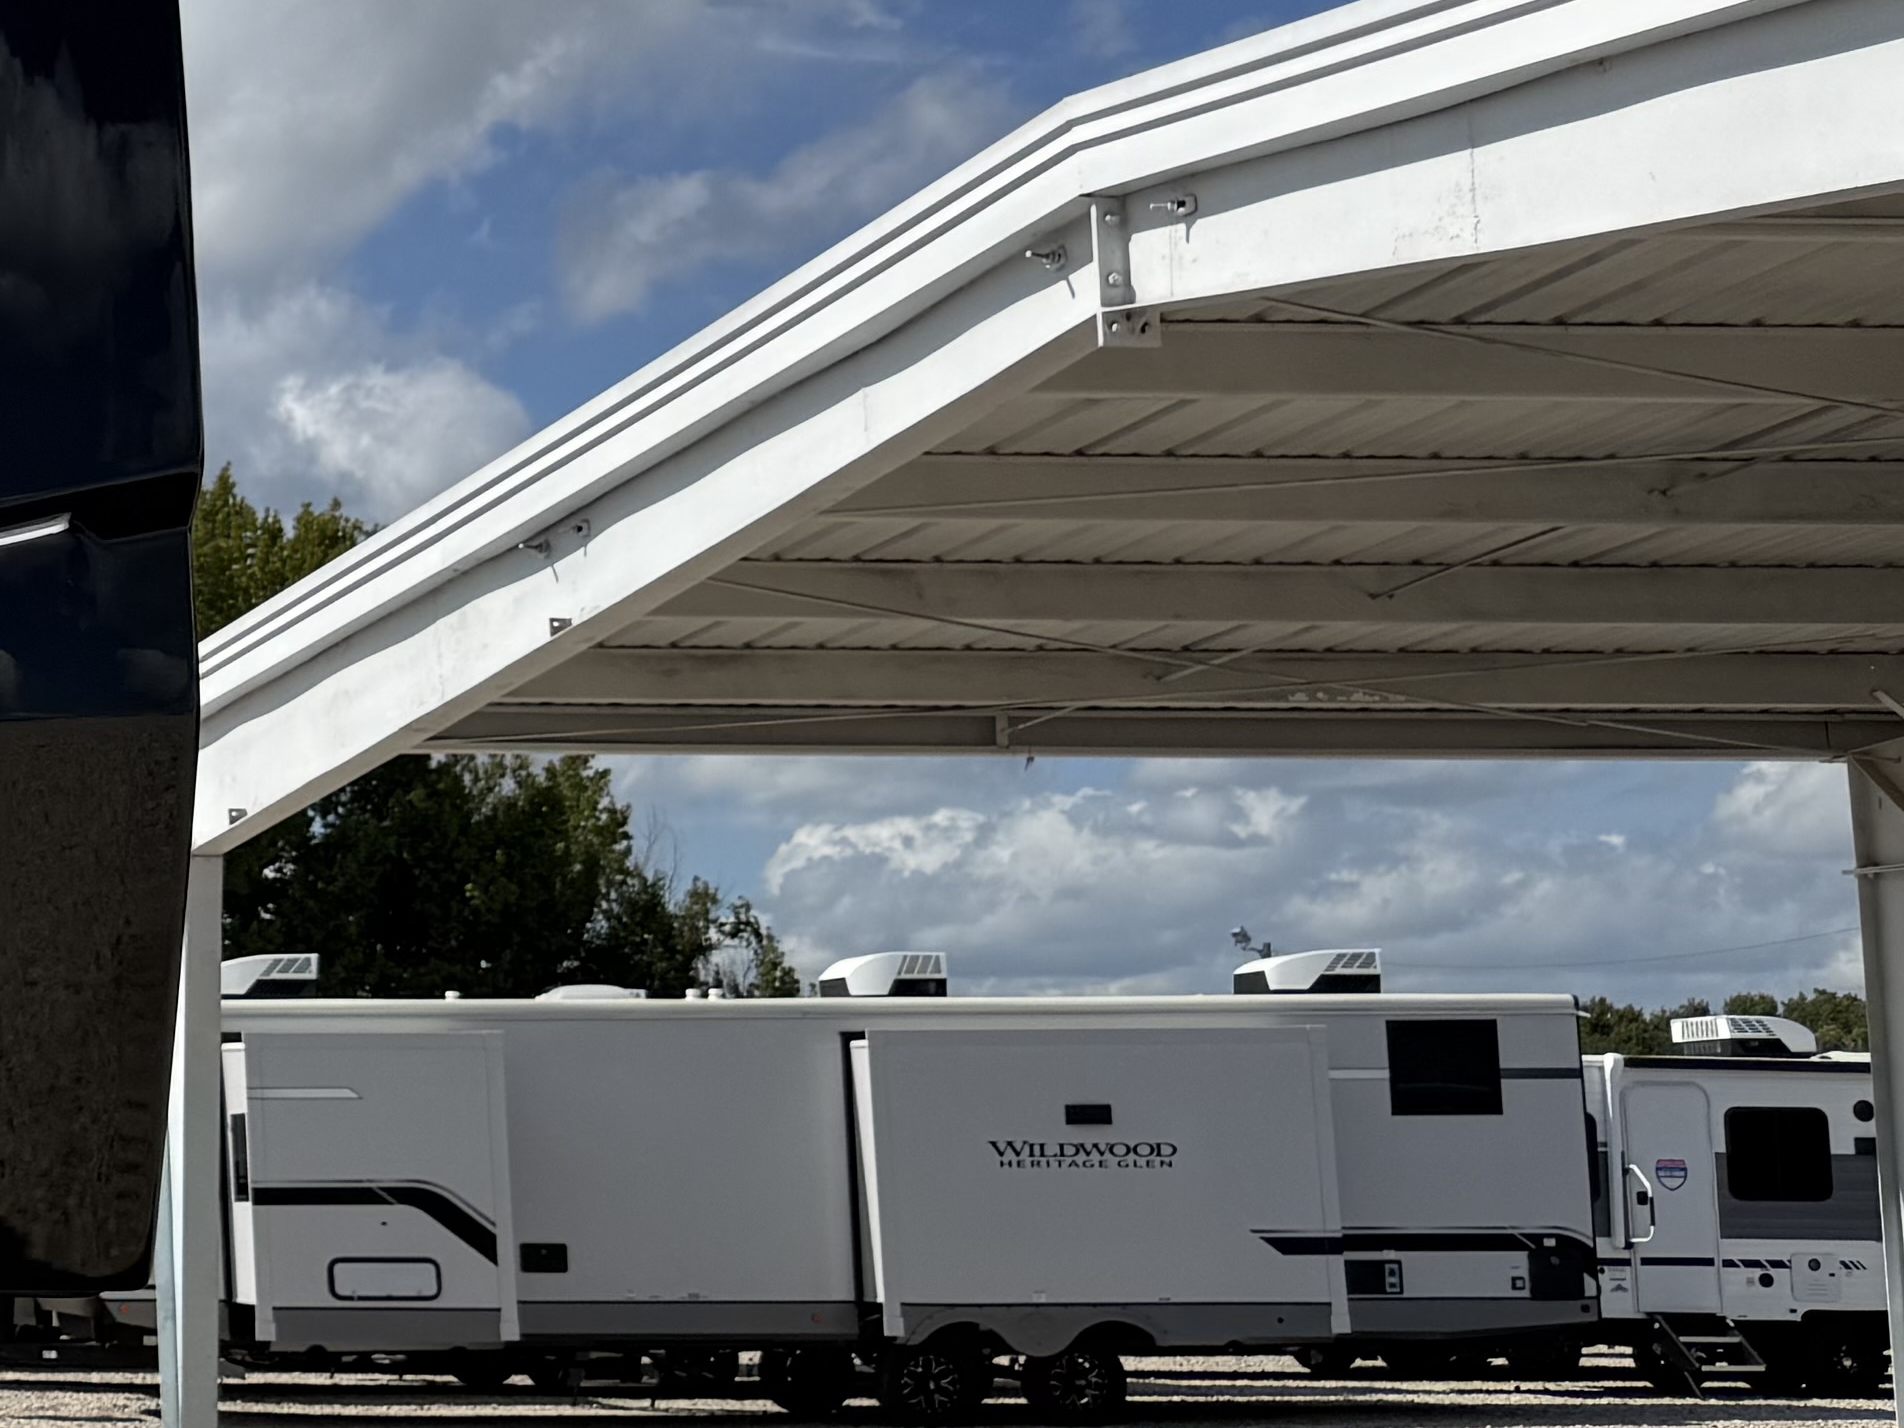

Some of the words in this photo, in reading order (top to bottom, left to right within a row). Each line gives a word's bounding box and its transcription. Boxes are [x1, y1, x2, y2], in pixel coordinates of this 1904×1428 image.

[987, 1139, 1178, 1158] WILDWOOD
[999, 1159, 1109, 1169] HERITAGE
[1117, 1159, 1173, 1169] GLEN
